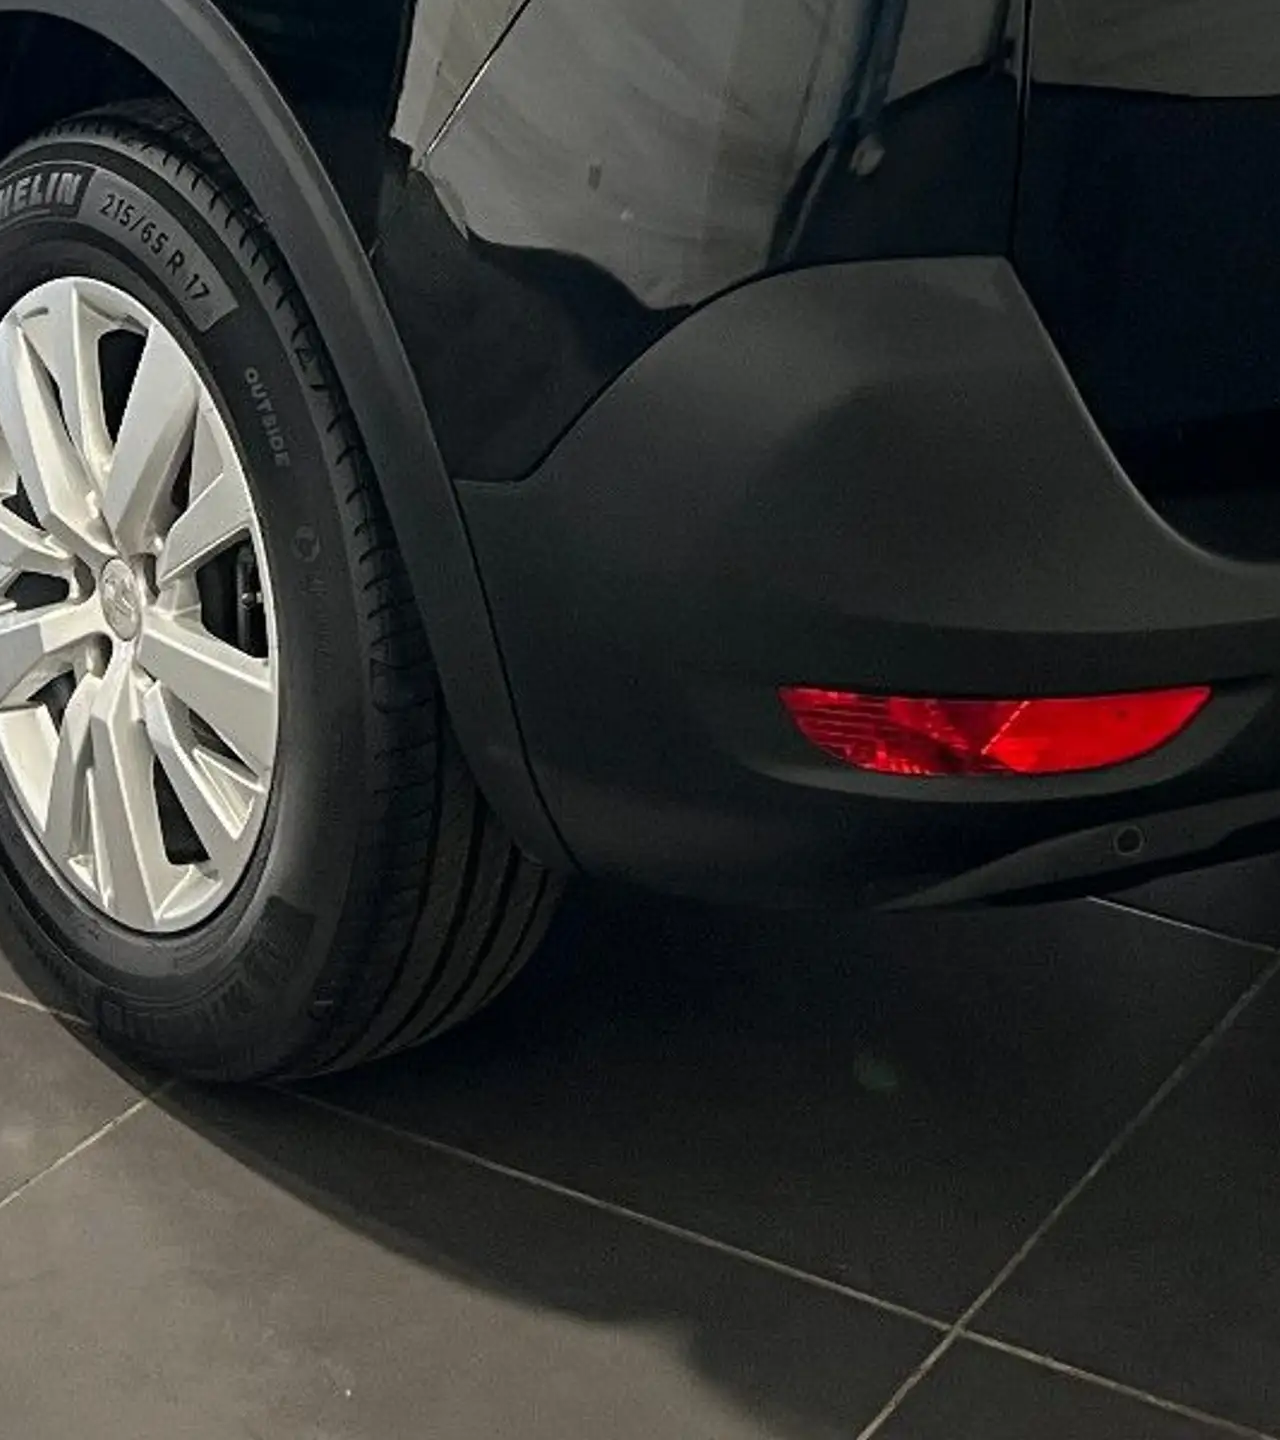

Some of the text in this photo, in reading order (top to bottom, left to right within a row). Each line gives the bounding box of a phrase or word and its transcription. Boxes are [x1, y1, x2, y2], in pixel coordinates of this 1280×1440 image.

[99, 193, 211, 301] 215/65 R 17
[244, 366, 291, 468] OUTSIDE
